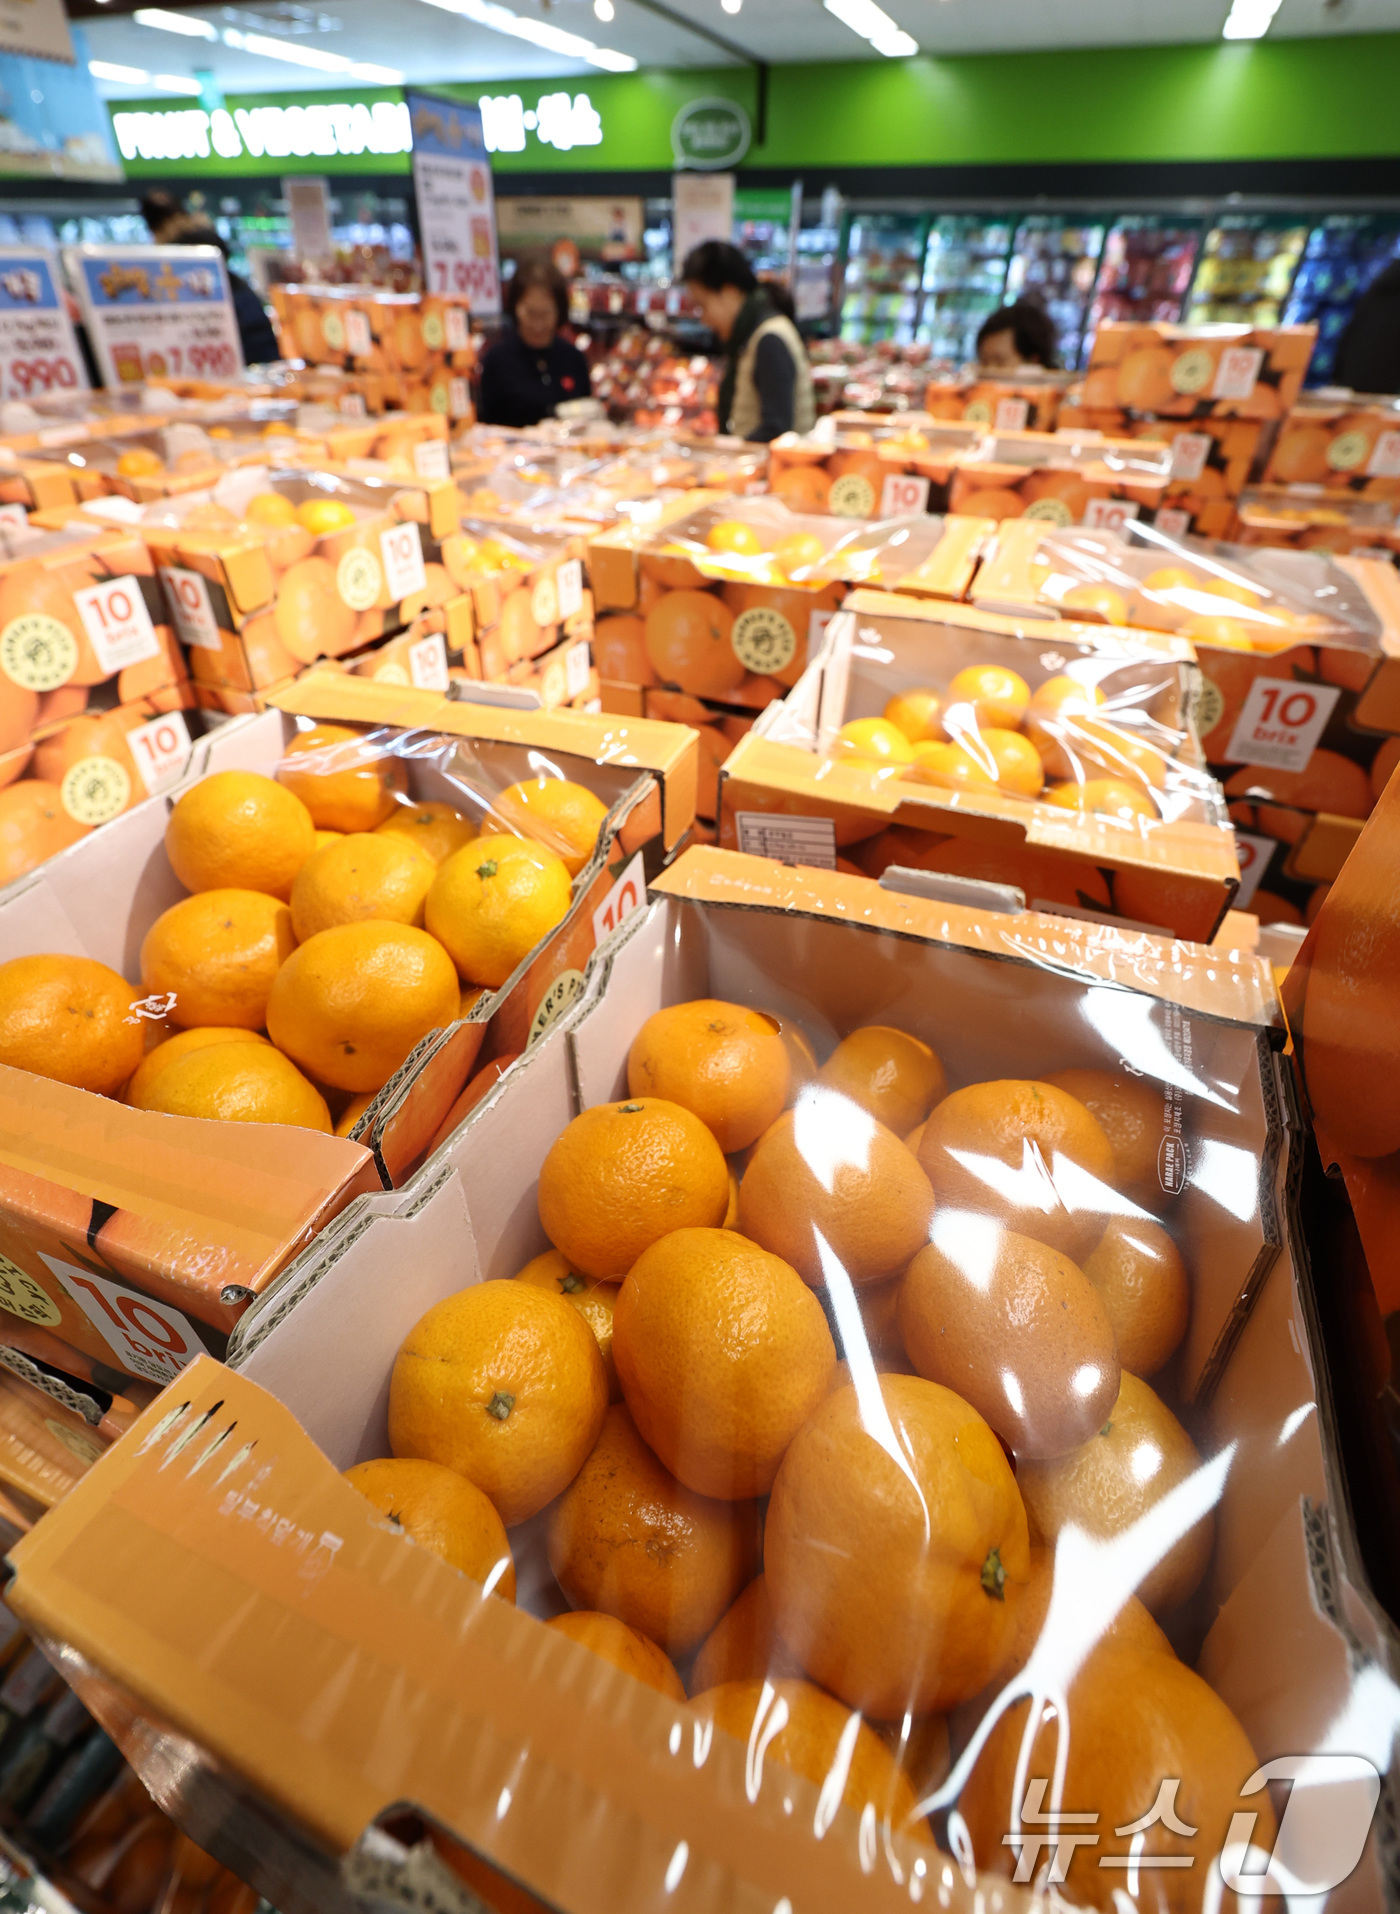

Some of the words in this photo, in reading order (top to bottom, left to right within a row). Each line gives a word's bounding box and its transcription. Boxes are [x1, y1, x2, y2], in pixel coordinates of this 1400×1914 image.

[893, 481, 920, 507] 10
[167, 575, 202, 609] 10
[88, 590, 133, 628] 10
[1262, 687, 1317, 728] 10
[139, 725, 178, 761] 10
[1252, 725, 1298, 746] brix
[122, 1015, 141, 1025] PP
[1165, 1141, 1175, 1162] PACK
[1164, 1163, 1174, 1188] NARAE
[68, 1275, 188, 1354] 10
